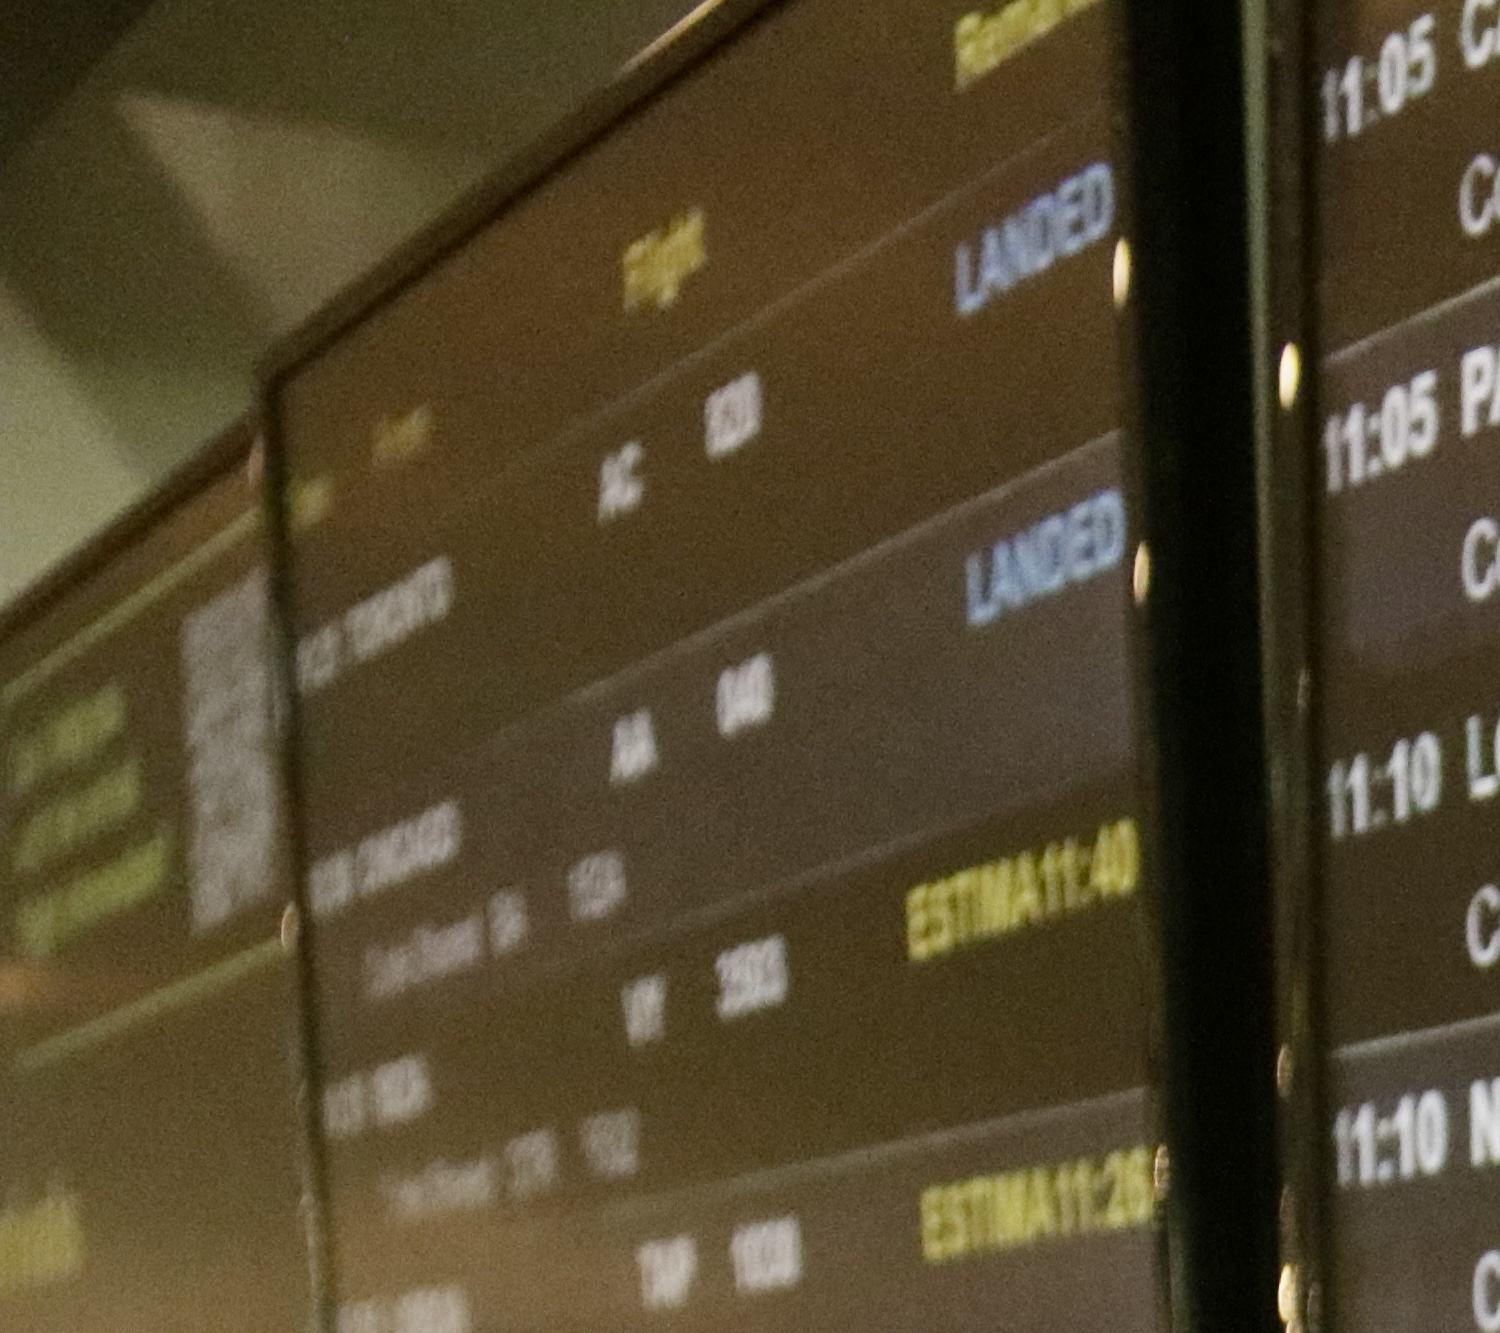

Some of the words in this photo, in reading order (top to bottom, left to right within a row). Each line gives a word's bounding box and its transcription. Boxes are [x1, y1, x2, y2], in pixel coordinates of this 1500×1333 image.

[1327, 14, 1436, 134] 11:05
[958, 164, 1111, 314] LANDED
[1328, 371, 1438, 486] 11:05
[969, 491, 1123, 623] LANDED
[1331, 733, 1441, 834] 11:10
[1338, 1091, 1447, 1183] 11:10
